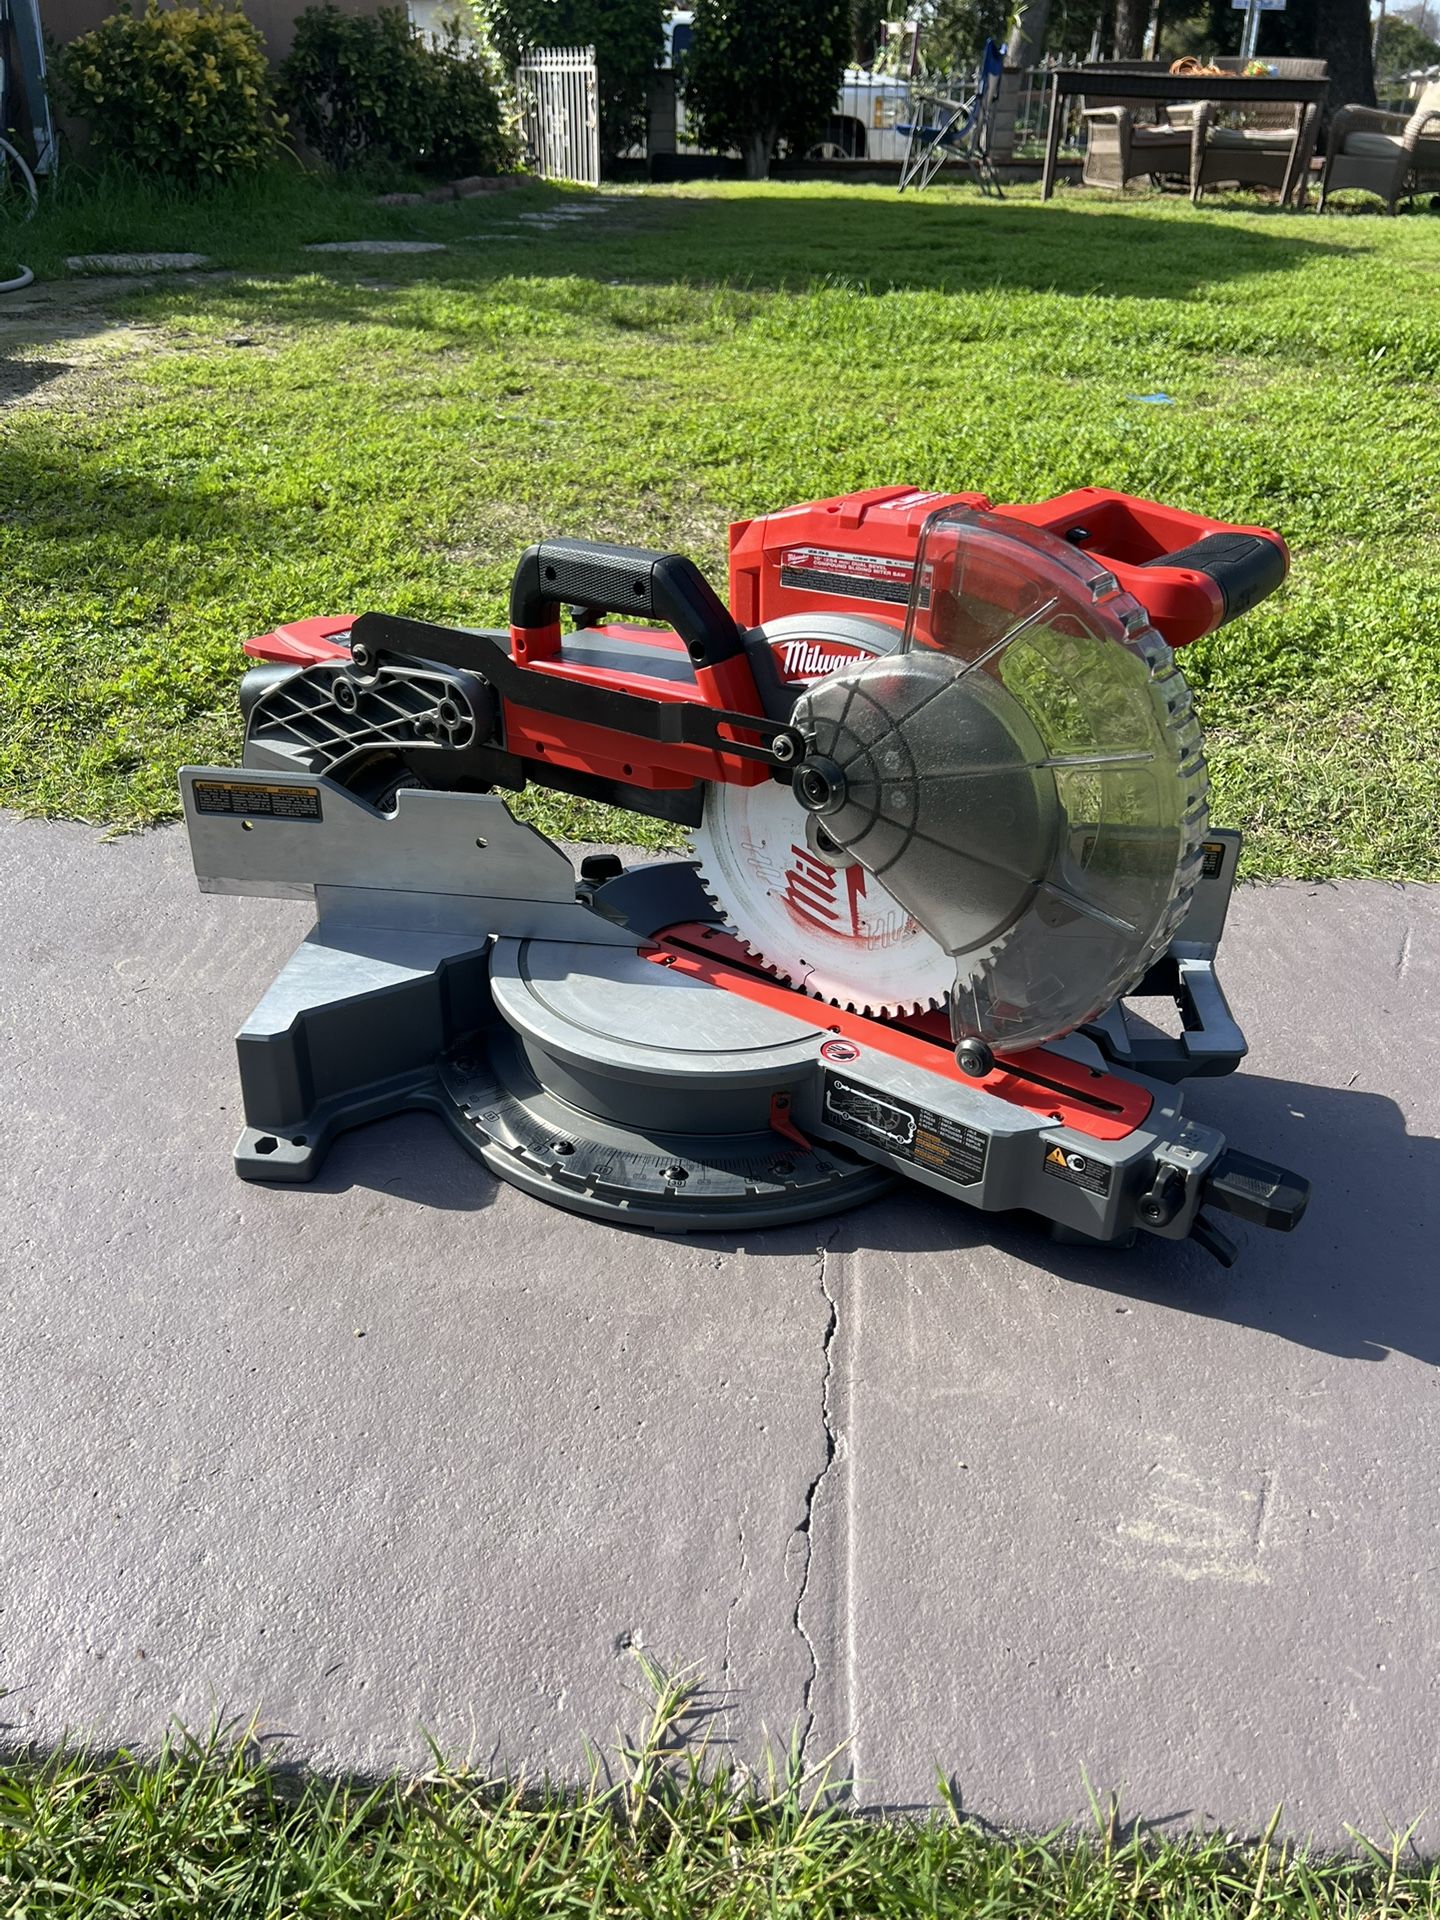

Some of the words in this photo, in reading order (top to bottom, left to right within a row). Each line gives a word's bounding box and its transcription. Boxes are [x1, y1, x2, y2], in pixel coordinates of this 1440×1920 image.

[813, 560, 846, 570] COMPOUND
[848, 565, 872, 574] SLIDING
[780, 640, 876, 675] Milwa
